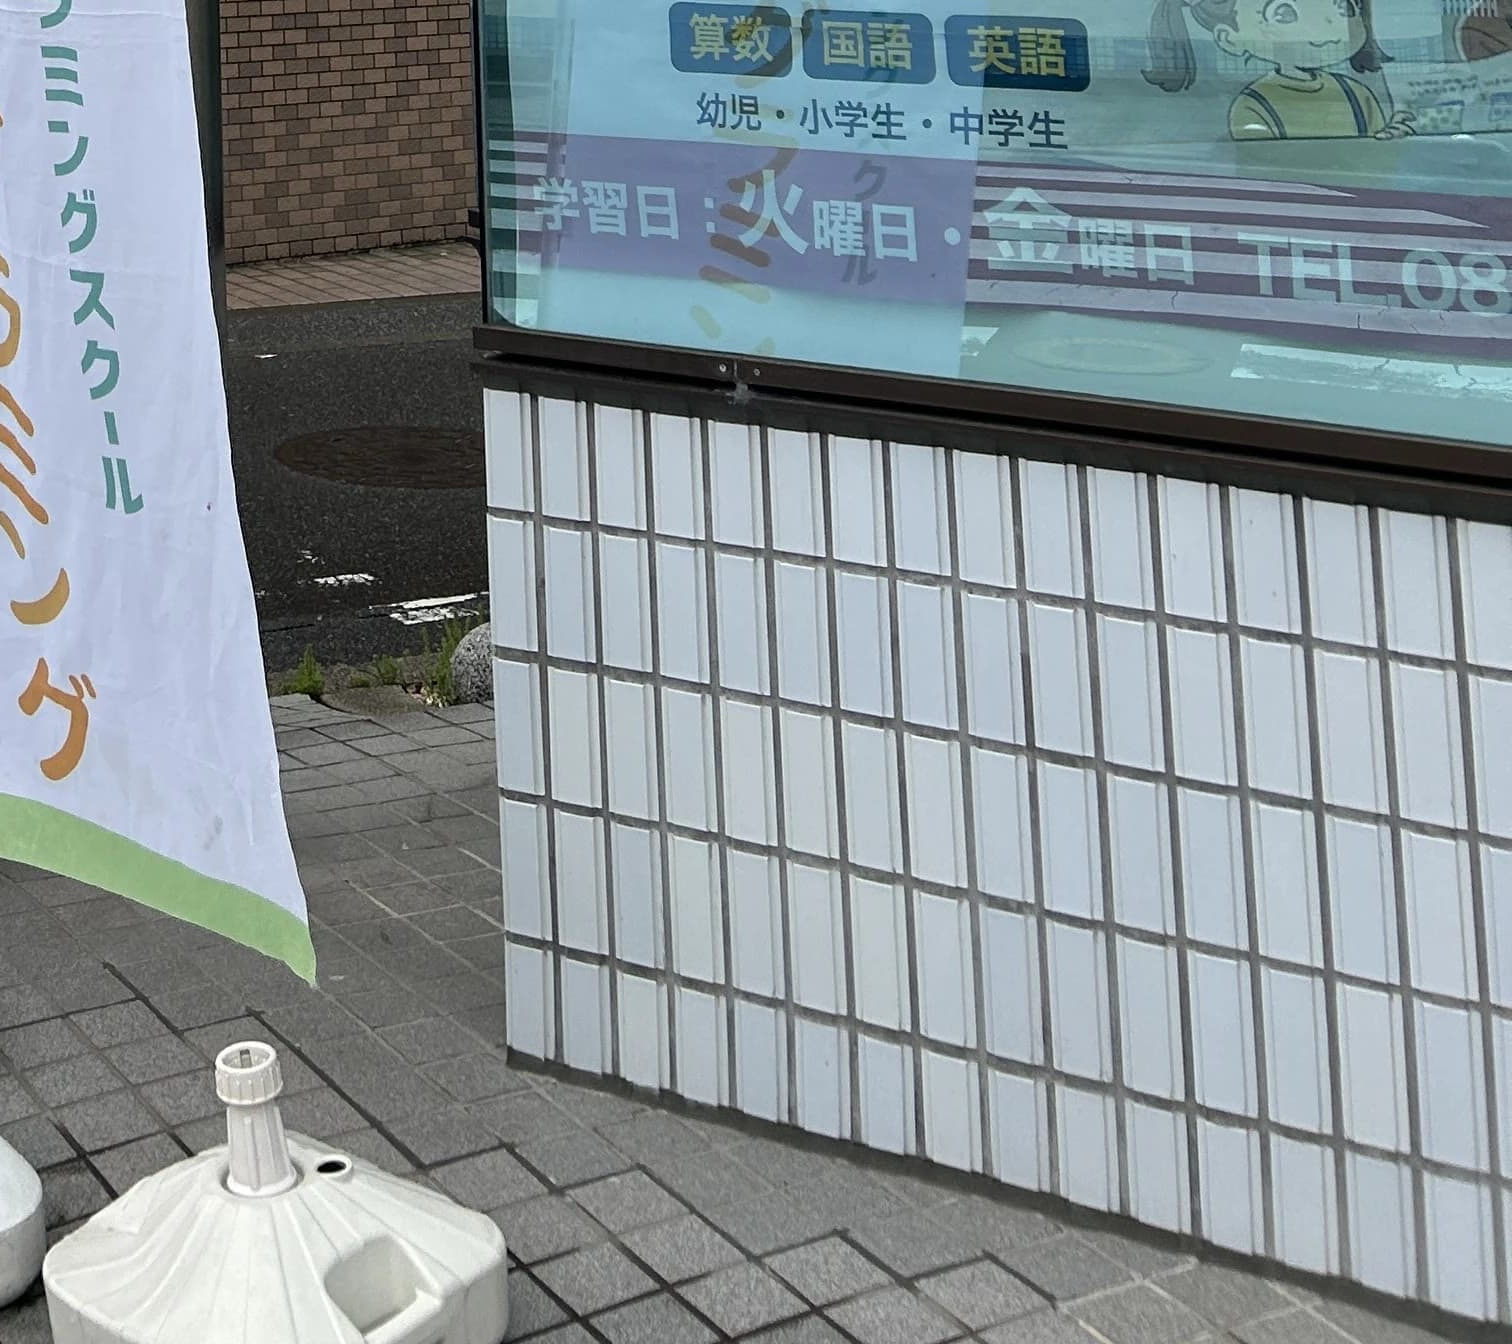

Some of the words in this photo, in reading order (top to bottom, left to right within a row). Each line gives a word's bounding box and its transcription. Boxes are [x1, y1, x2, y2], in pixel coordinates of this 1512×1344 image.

[689, 13, 775, 63] 算数
[821, 20, 914, 72] 国語
[966, 25, 1067, 79] 英語
